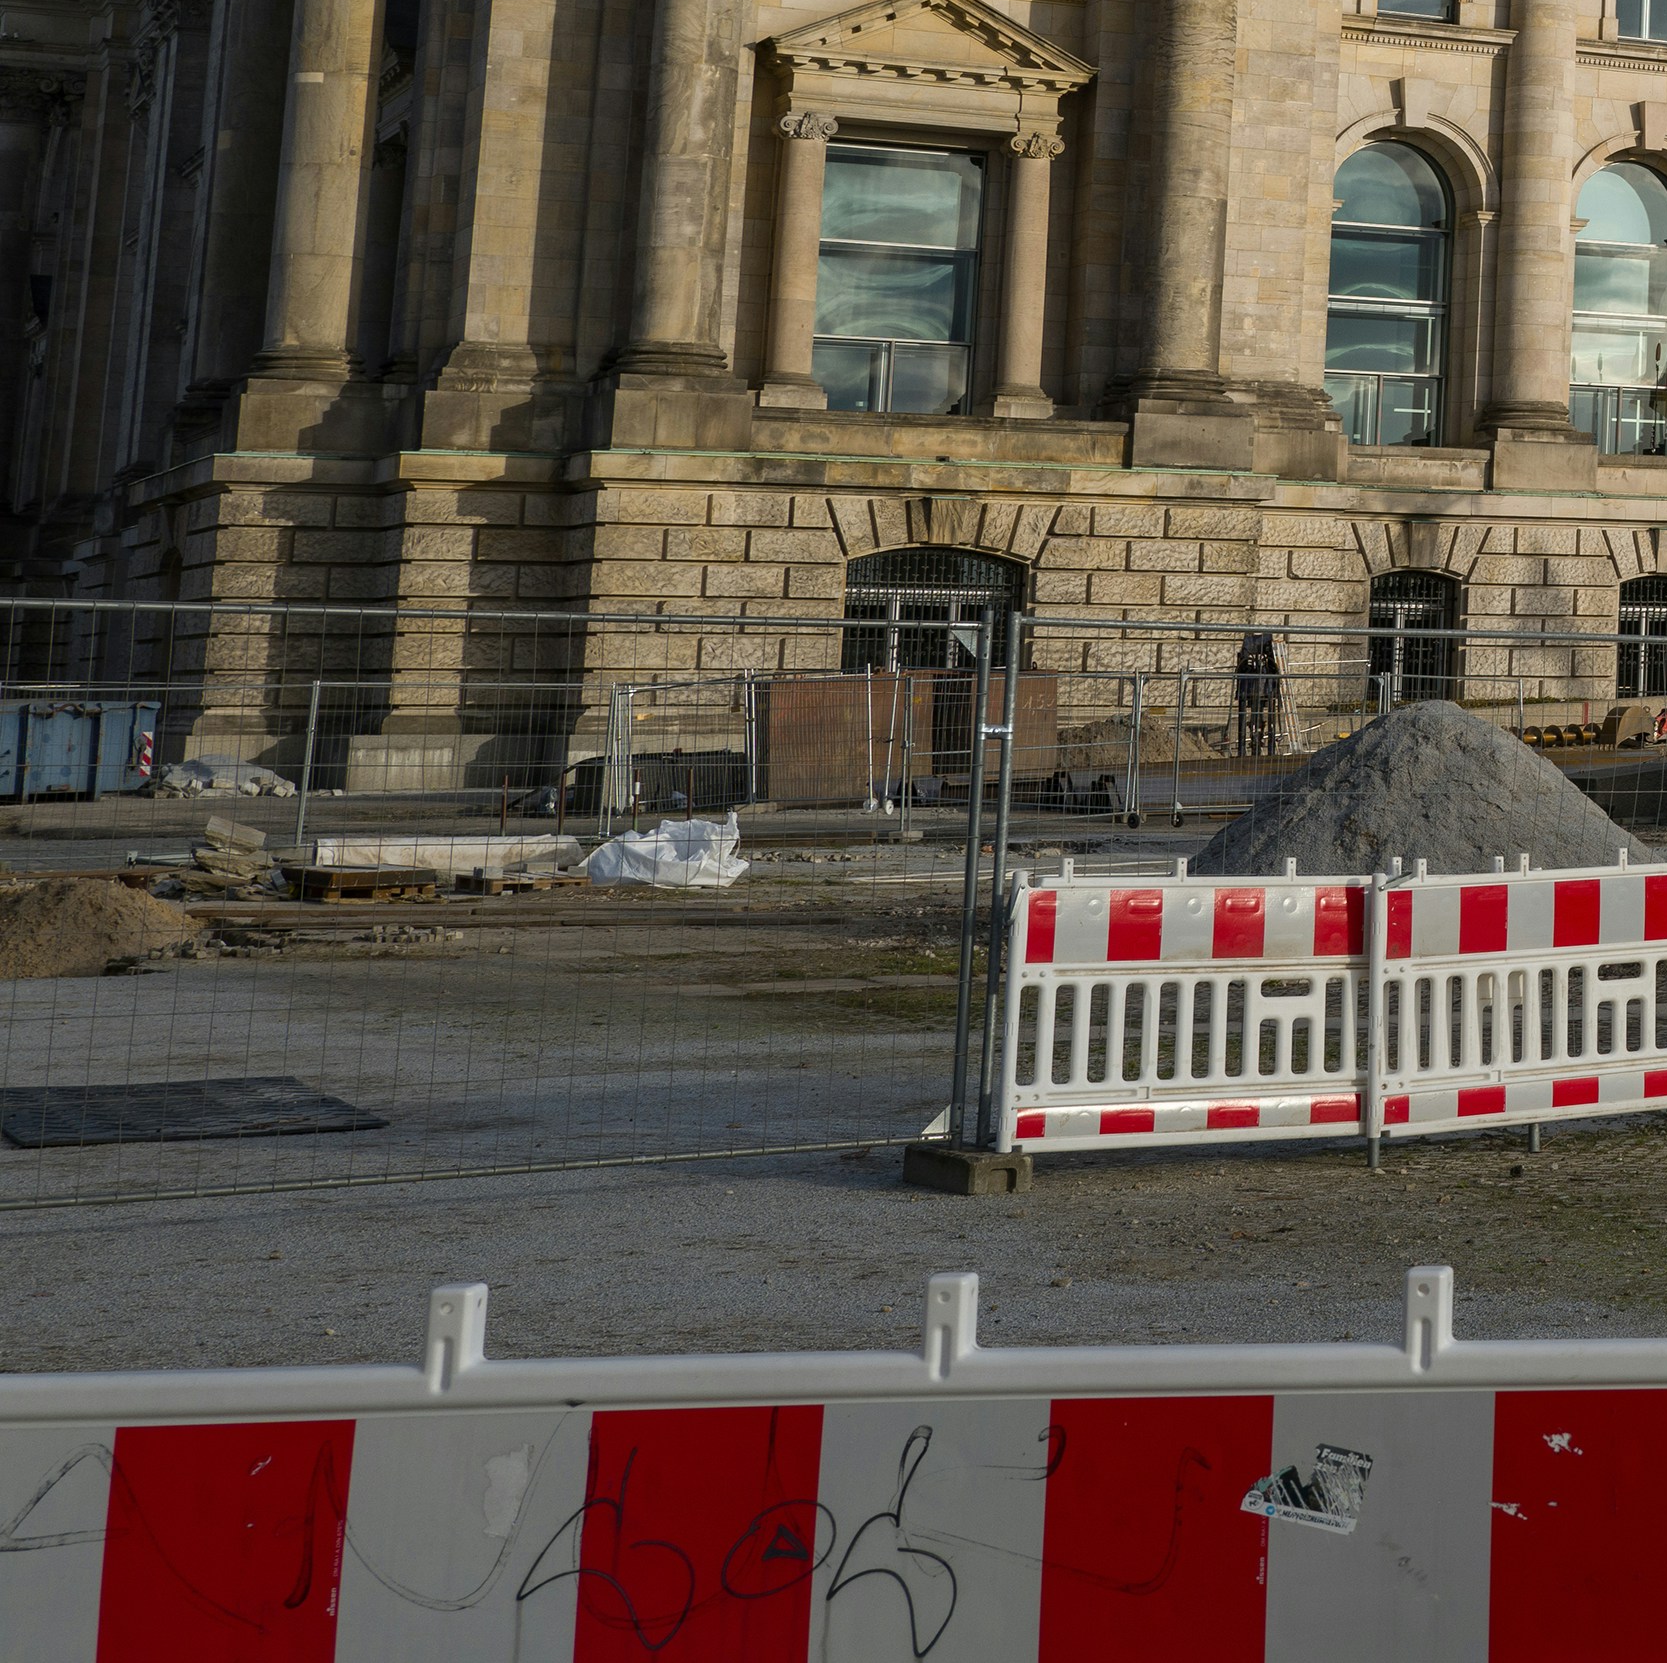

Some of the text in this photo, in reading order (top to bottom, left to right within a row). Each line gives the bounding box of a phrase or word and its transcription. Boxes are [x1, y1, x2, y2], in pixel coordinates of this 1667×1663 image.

[1320, 1448, 1371, 1469] Familien
[1256, 1557, 1265, 1584] nissen
[326, 1587, 337, 1616] nissen
